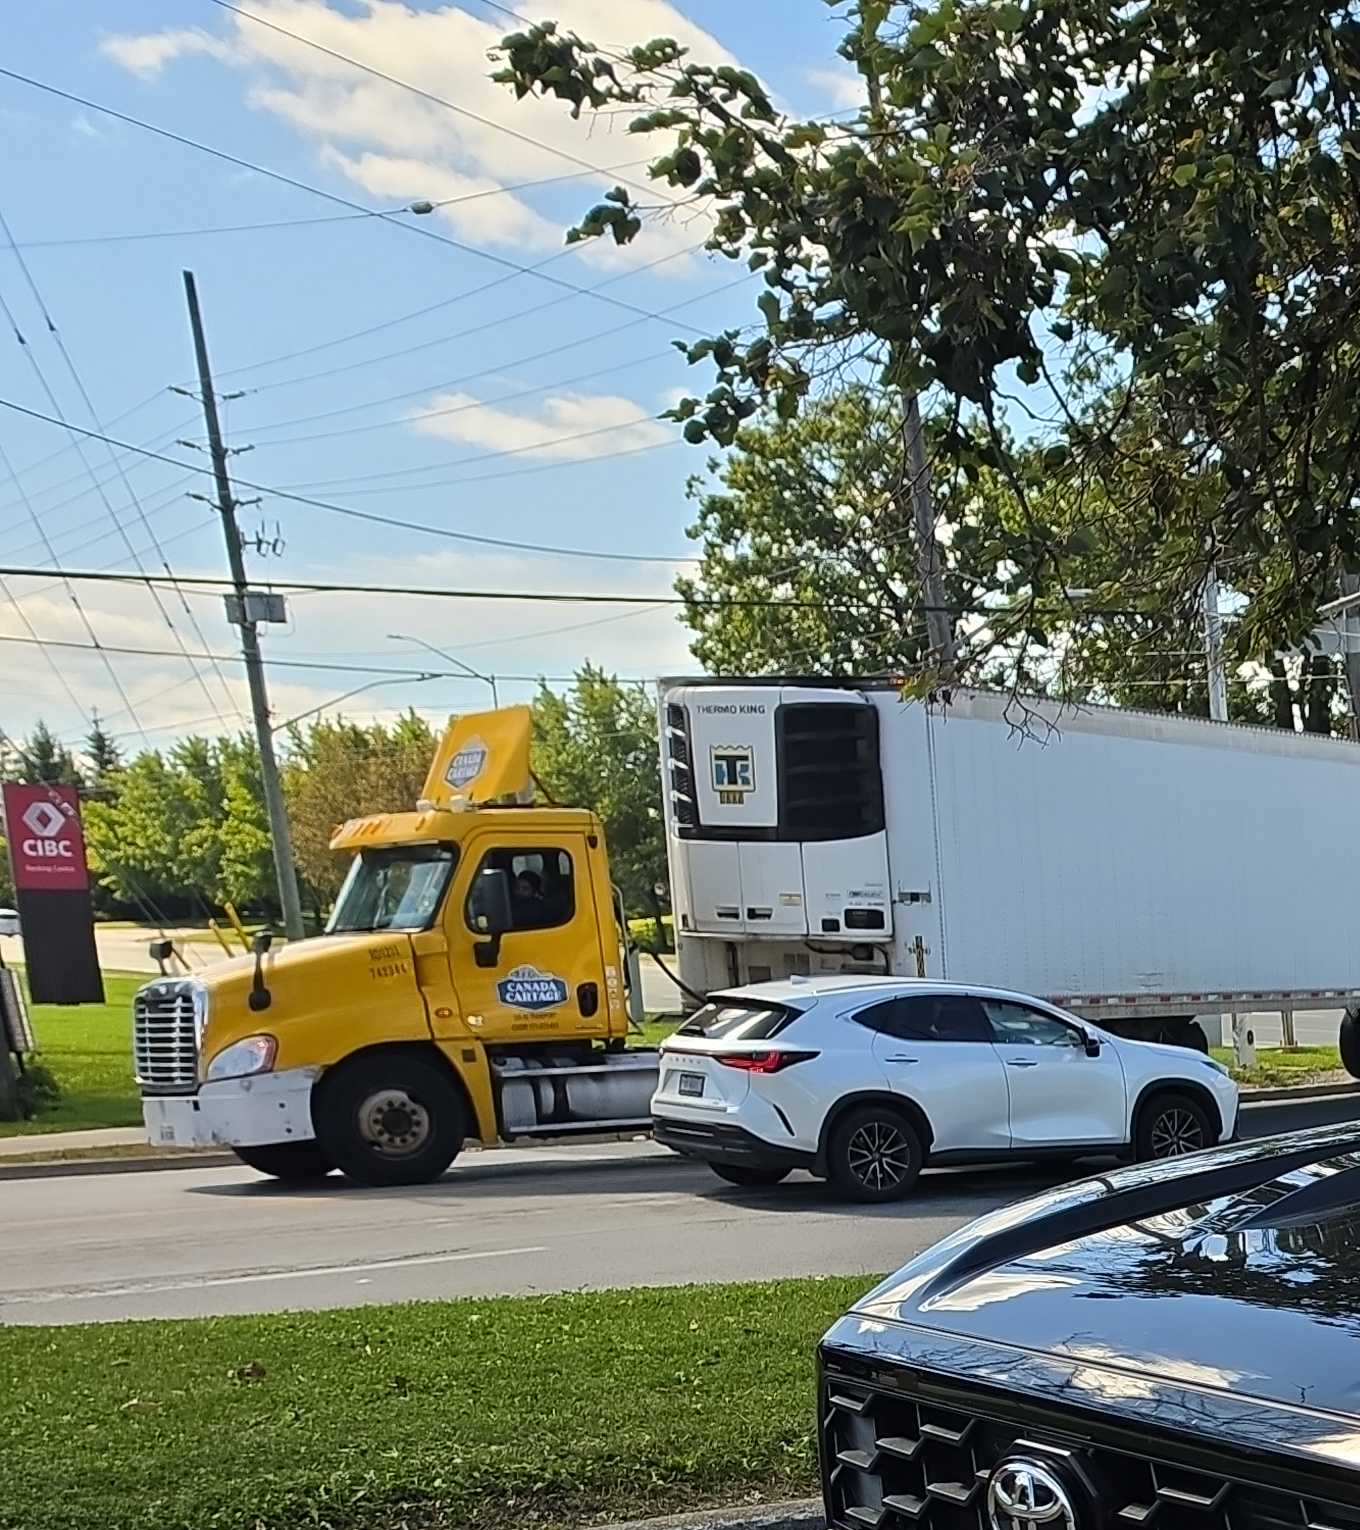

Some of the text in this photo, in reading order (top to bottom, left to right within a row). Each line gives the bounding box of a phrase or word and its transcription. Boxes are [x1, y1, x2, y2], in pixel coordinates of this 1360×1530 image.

[696, 704, 766, 715] THERMO KING
[22, 839, 74, 858] CIBC
[506, 981, 558, 992] CANADA
[505, 991, 562, 1003] CARTAGE
